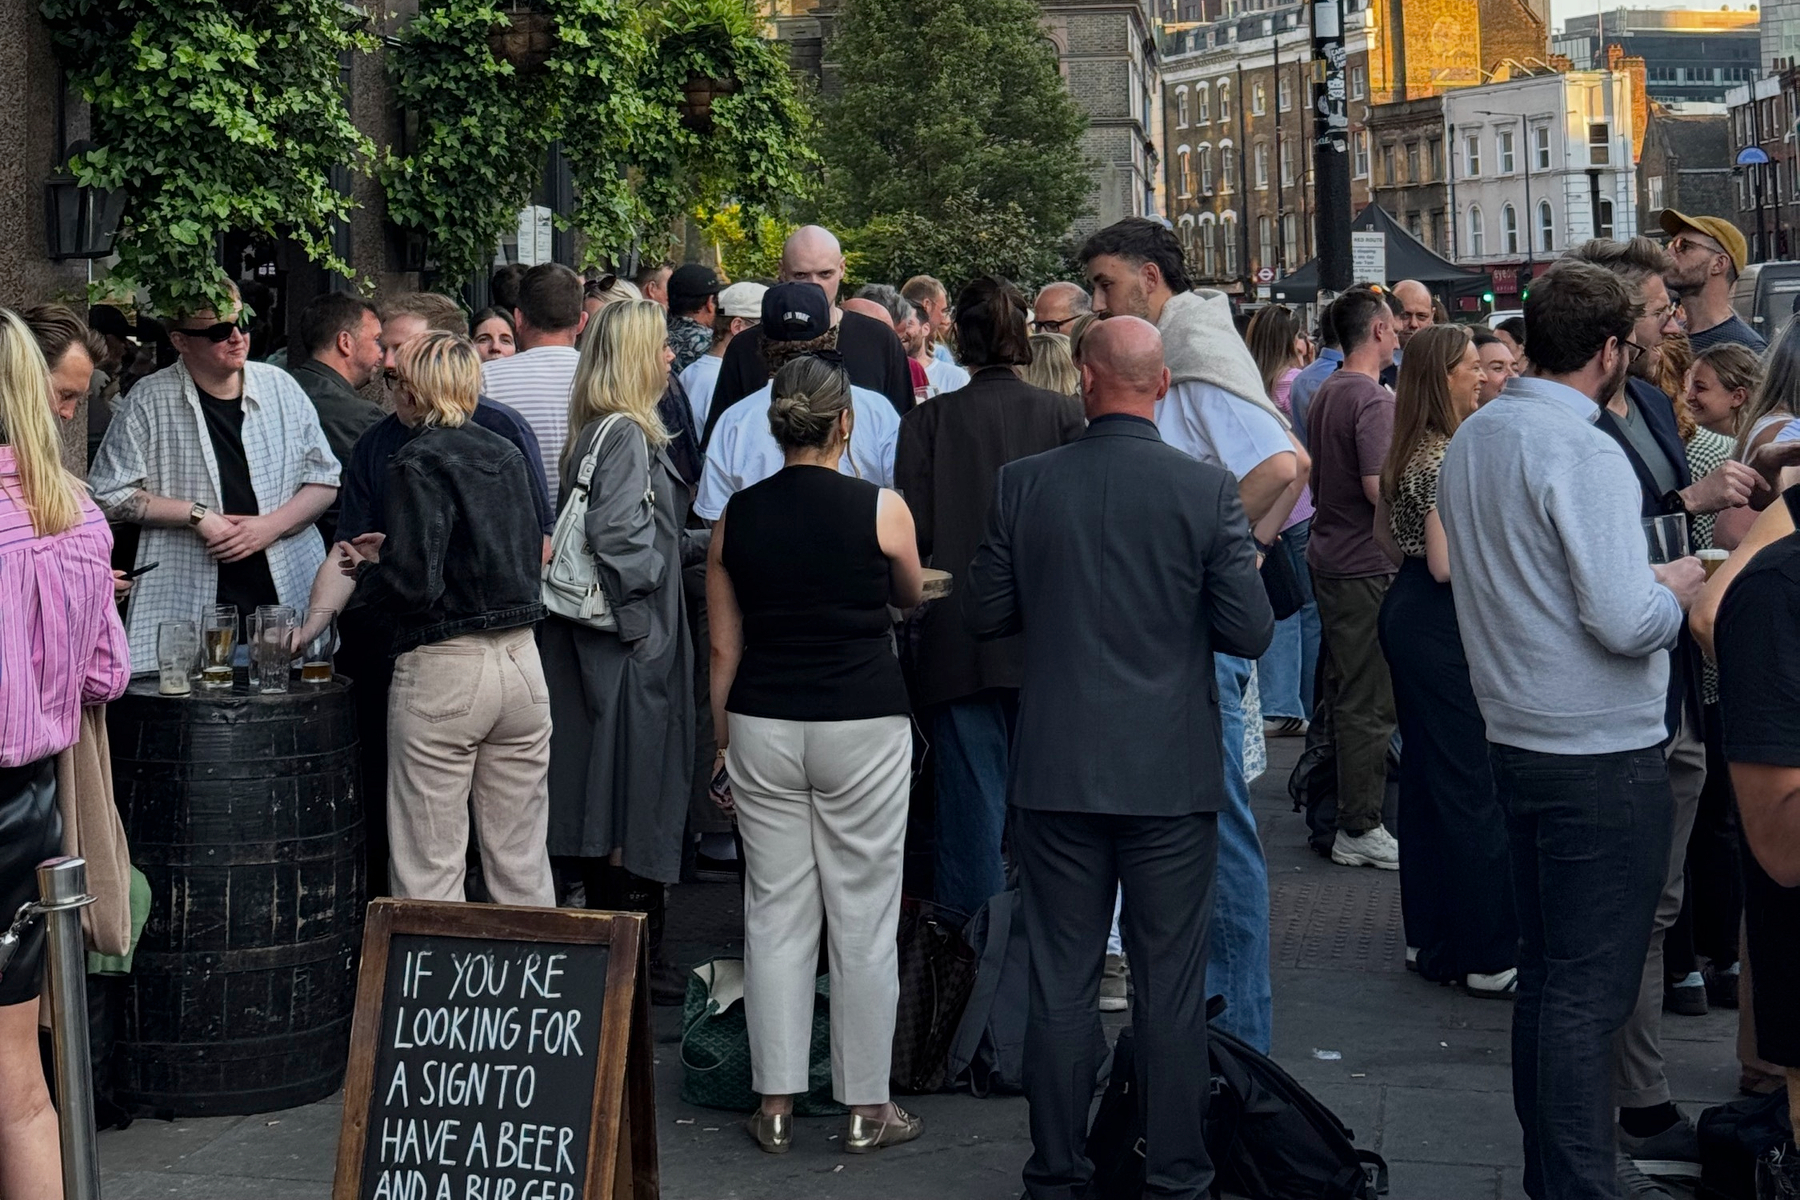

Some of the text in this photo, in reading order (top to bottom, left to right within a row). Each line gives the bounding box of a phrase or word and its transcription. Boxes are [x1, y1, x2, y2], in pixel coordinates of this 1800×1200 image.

[403, 951, 568, 1001] IF YOU'RE
[394, 1006, 584, 1057] LOOKING FOR
[385, 1060, 536, 1110] A SIGN TO
[380, 1117, 575, 1175] HAVE A BEER
[372, 1170, 428, 1200] AND
[435, 1172, 452, 1200] A
